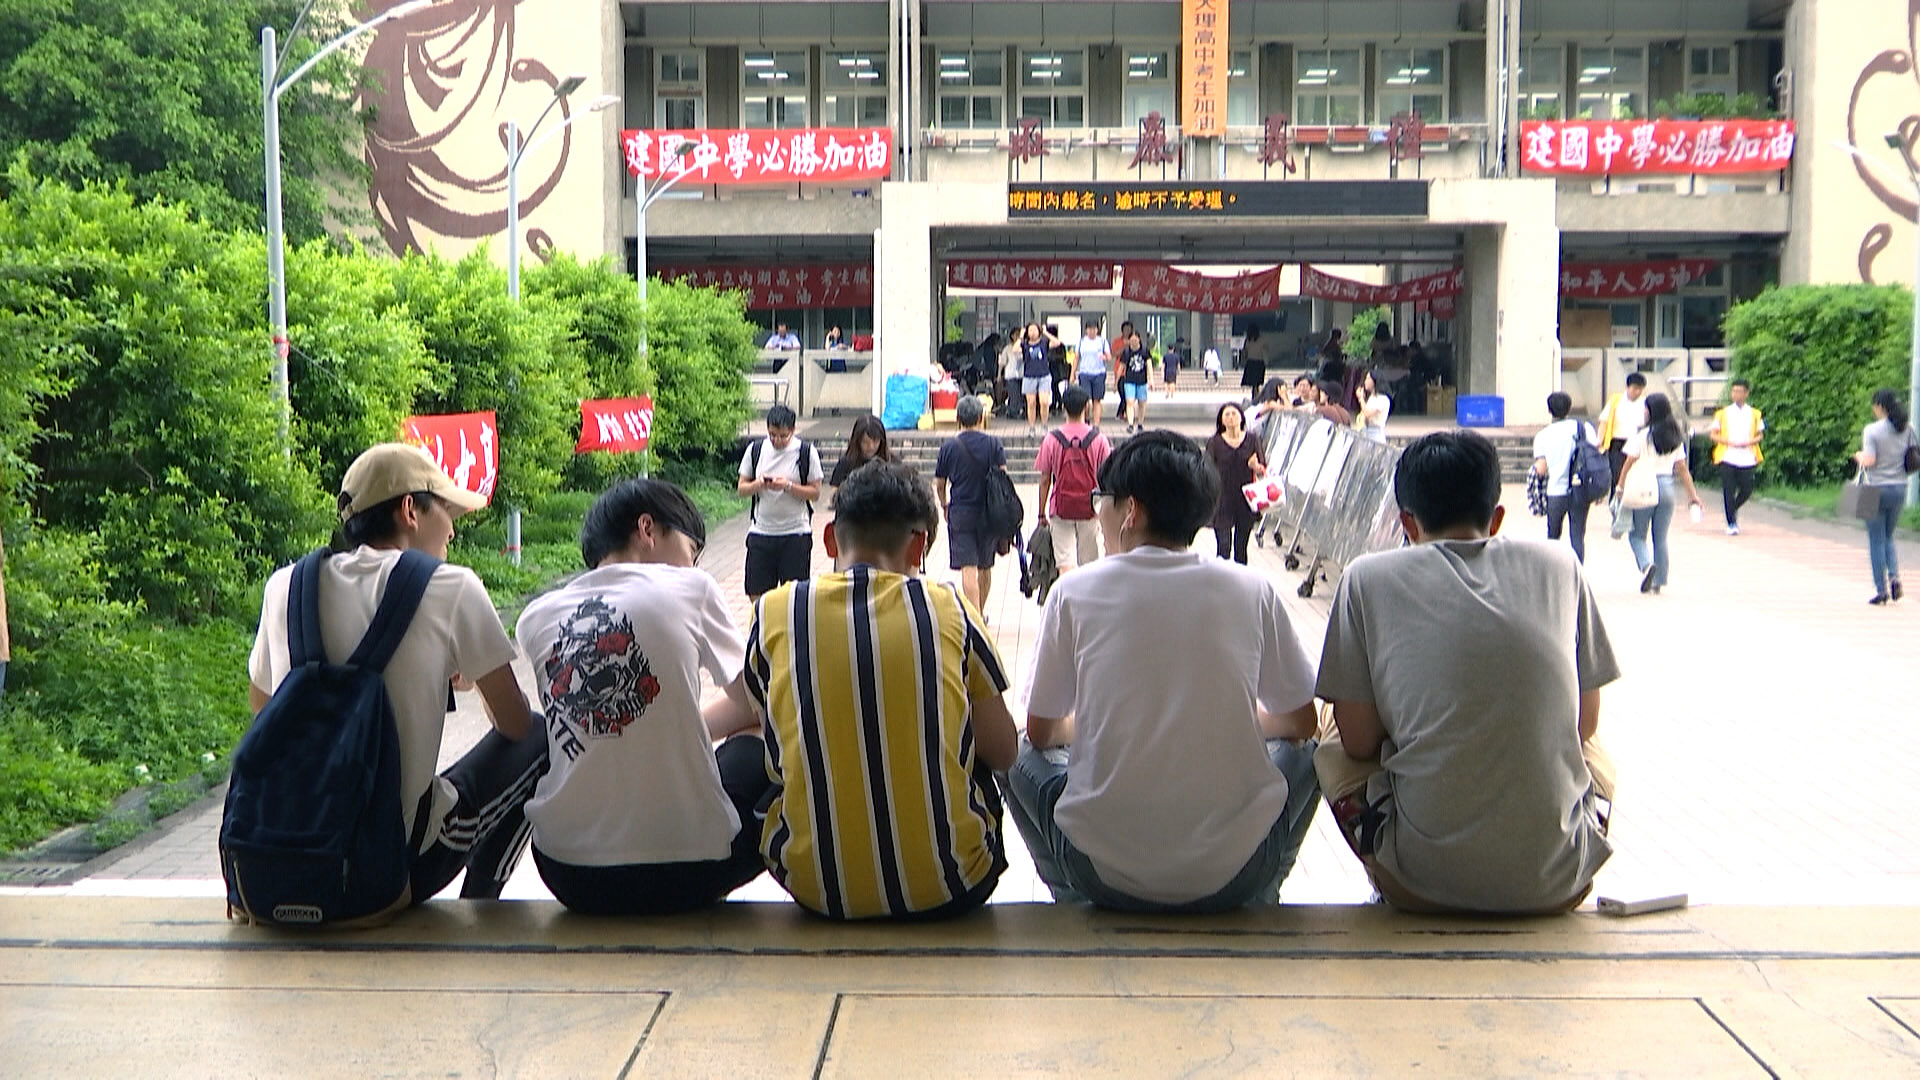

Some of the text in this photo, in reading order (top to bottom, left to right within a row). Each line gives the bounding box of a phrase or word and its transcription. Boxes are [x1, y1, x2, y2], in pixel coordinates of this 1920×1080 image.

[626, 131, 887, 180] 建國中學必勝加油
[1526, 123, 1795, 171] 建國中學必勝加油
[953, 262, 1109, 285] 建國高中必勝加油
